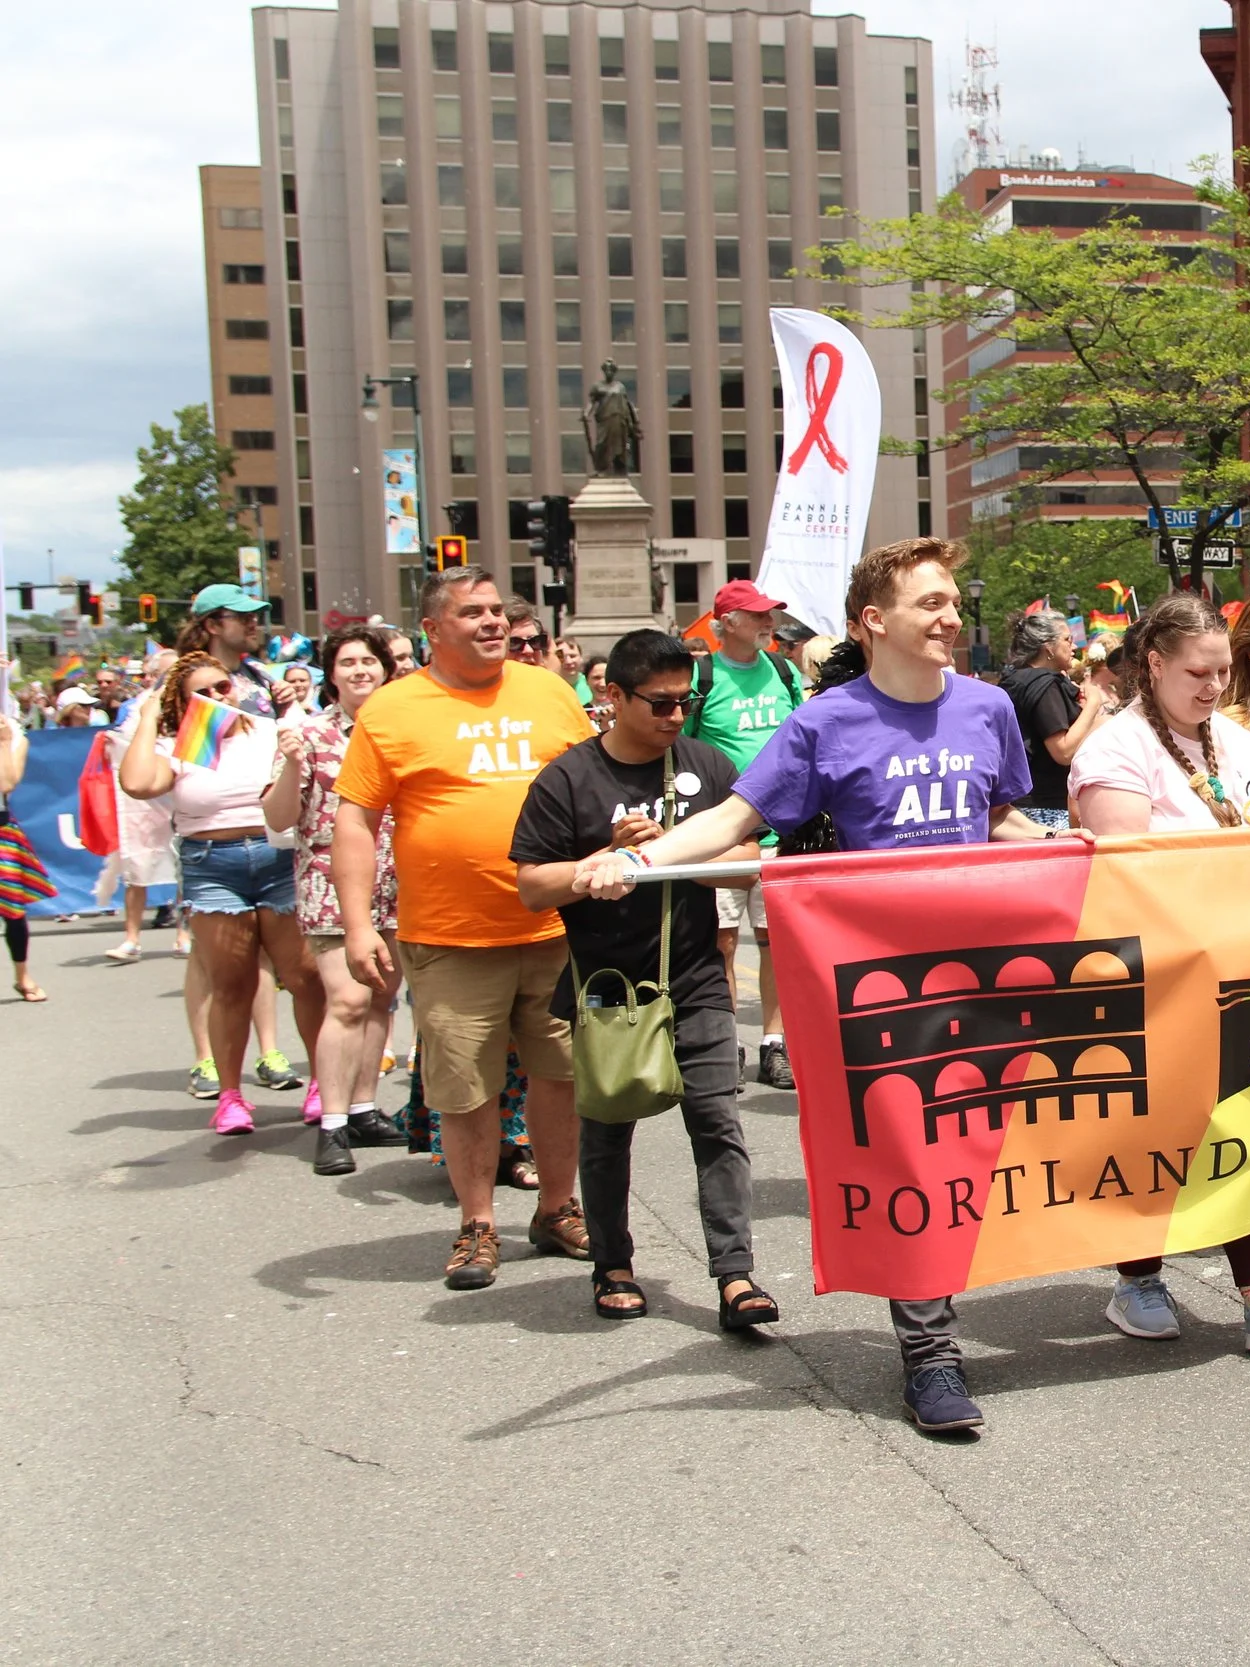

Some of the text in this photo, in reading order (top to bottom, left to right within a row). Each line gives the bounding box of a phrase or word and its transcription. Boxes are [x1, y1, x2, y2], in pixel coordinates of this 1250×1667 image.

[1000, 173, 1031, 187] Bank
[1045, 174, 1096, 188] America
[782, 512, 850, 525] EABODY
[783, 502, 850, 514] RANNIE
[805, 525, 849, 535] CENTER
[732, 693, 778, 711] Art for
[456, 715, 533, 740] Art for
[737, 707, 781, 731] ALL
[468, 739, 540, 774] ALL
[886, 748, 975, 779] Art for
[893, 780, 971, 826] ALL
[895, 830, 930, 840] PORTLAND
[931, 826, 962, 835] MUSEUM
[838, 1137, 1248, 1237] PORTLAND
